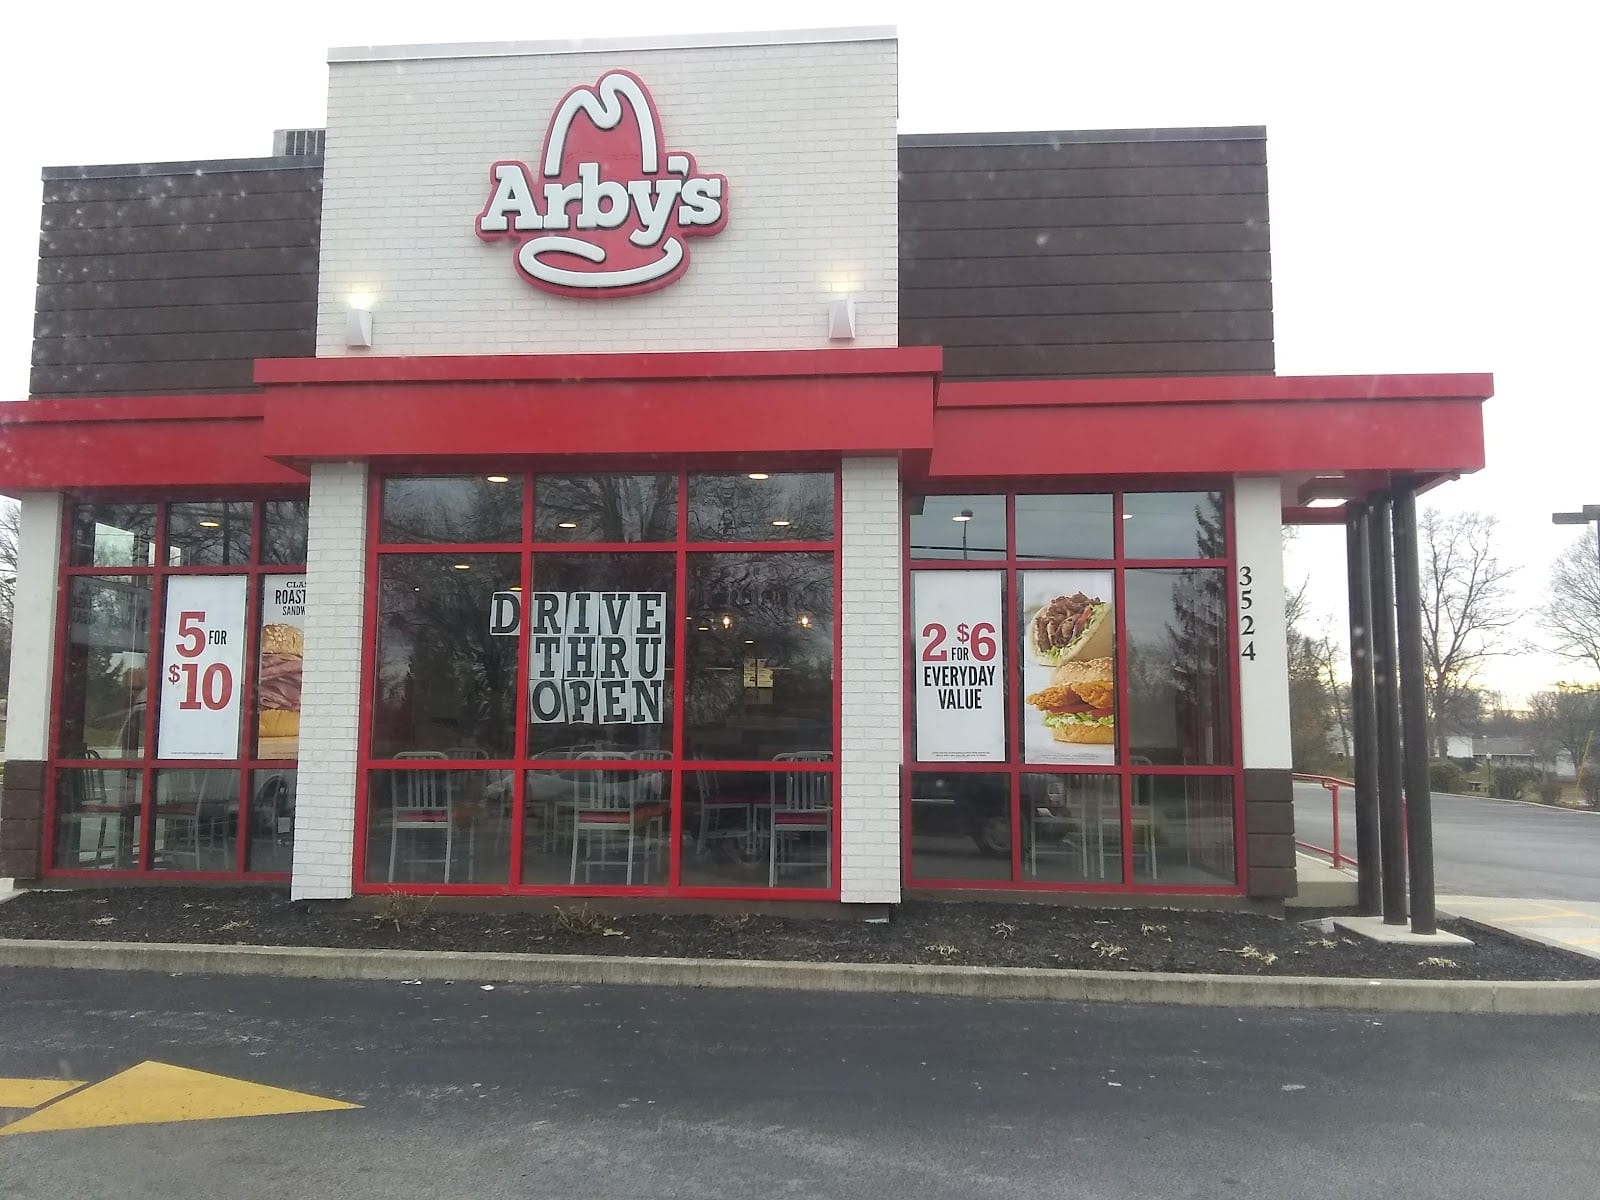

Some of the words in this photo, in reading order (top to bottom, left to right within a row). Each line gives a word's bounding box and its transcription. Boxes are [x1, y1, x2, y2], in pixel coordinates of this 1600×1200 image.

[480, 155, 722, 247] Arby's
[492, 593, 662, 634] DRIVE
[1239, 566, 1256, 661] 3524
[175, 611, 206, 658] 5
[209, 630, 227, 645] FOR
[922, 623, 948, 662] 2
[951, 647, 969, 661] FOR
[956, 622, 997, 662] $6
[535, 637, 662, 679] THRU
[924, 666, 996, 687] EVERYDAY
[168, 662, 233, 711] $10
[532, 680, 662, 722] OPEN
[938, 689, 983, 710] VALUE
